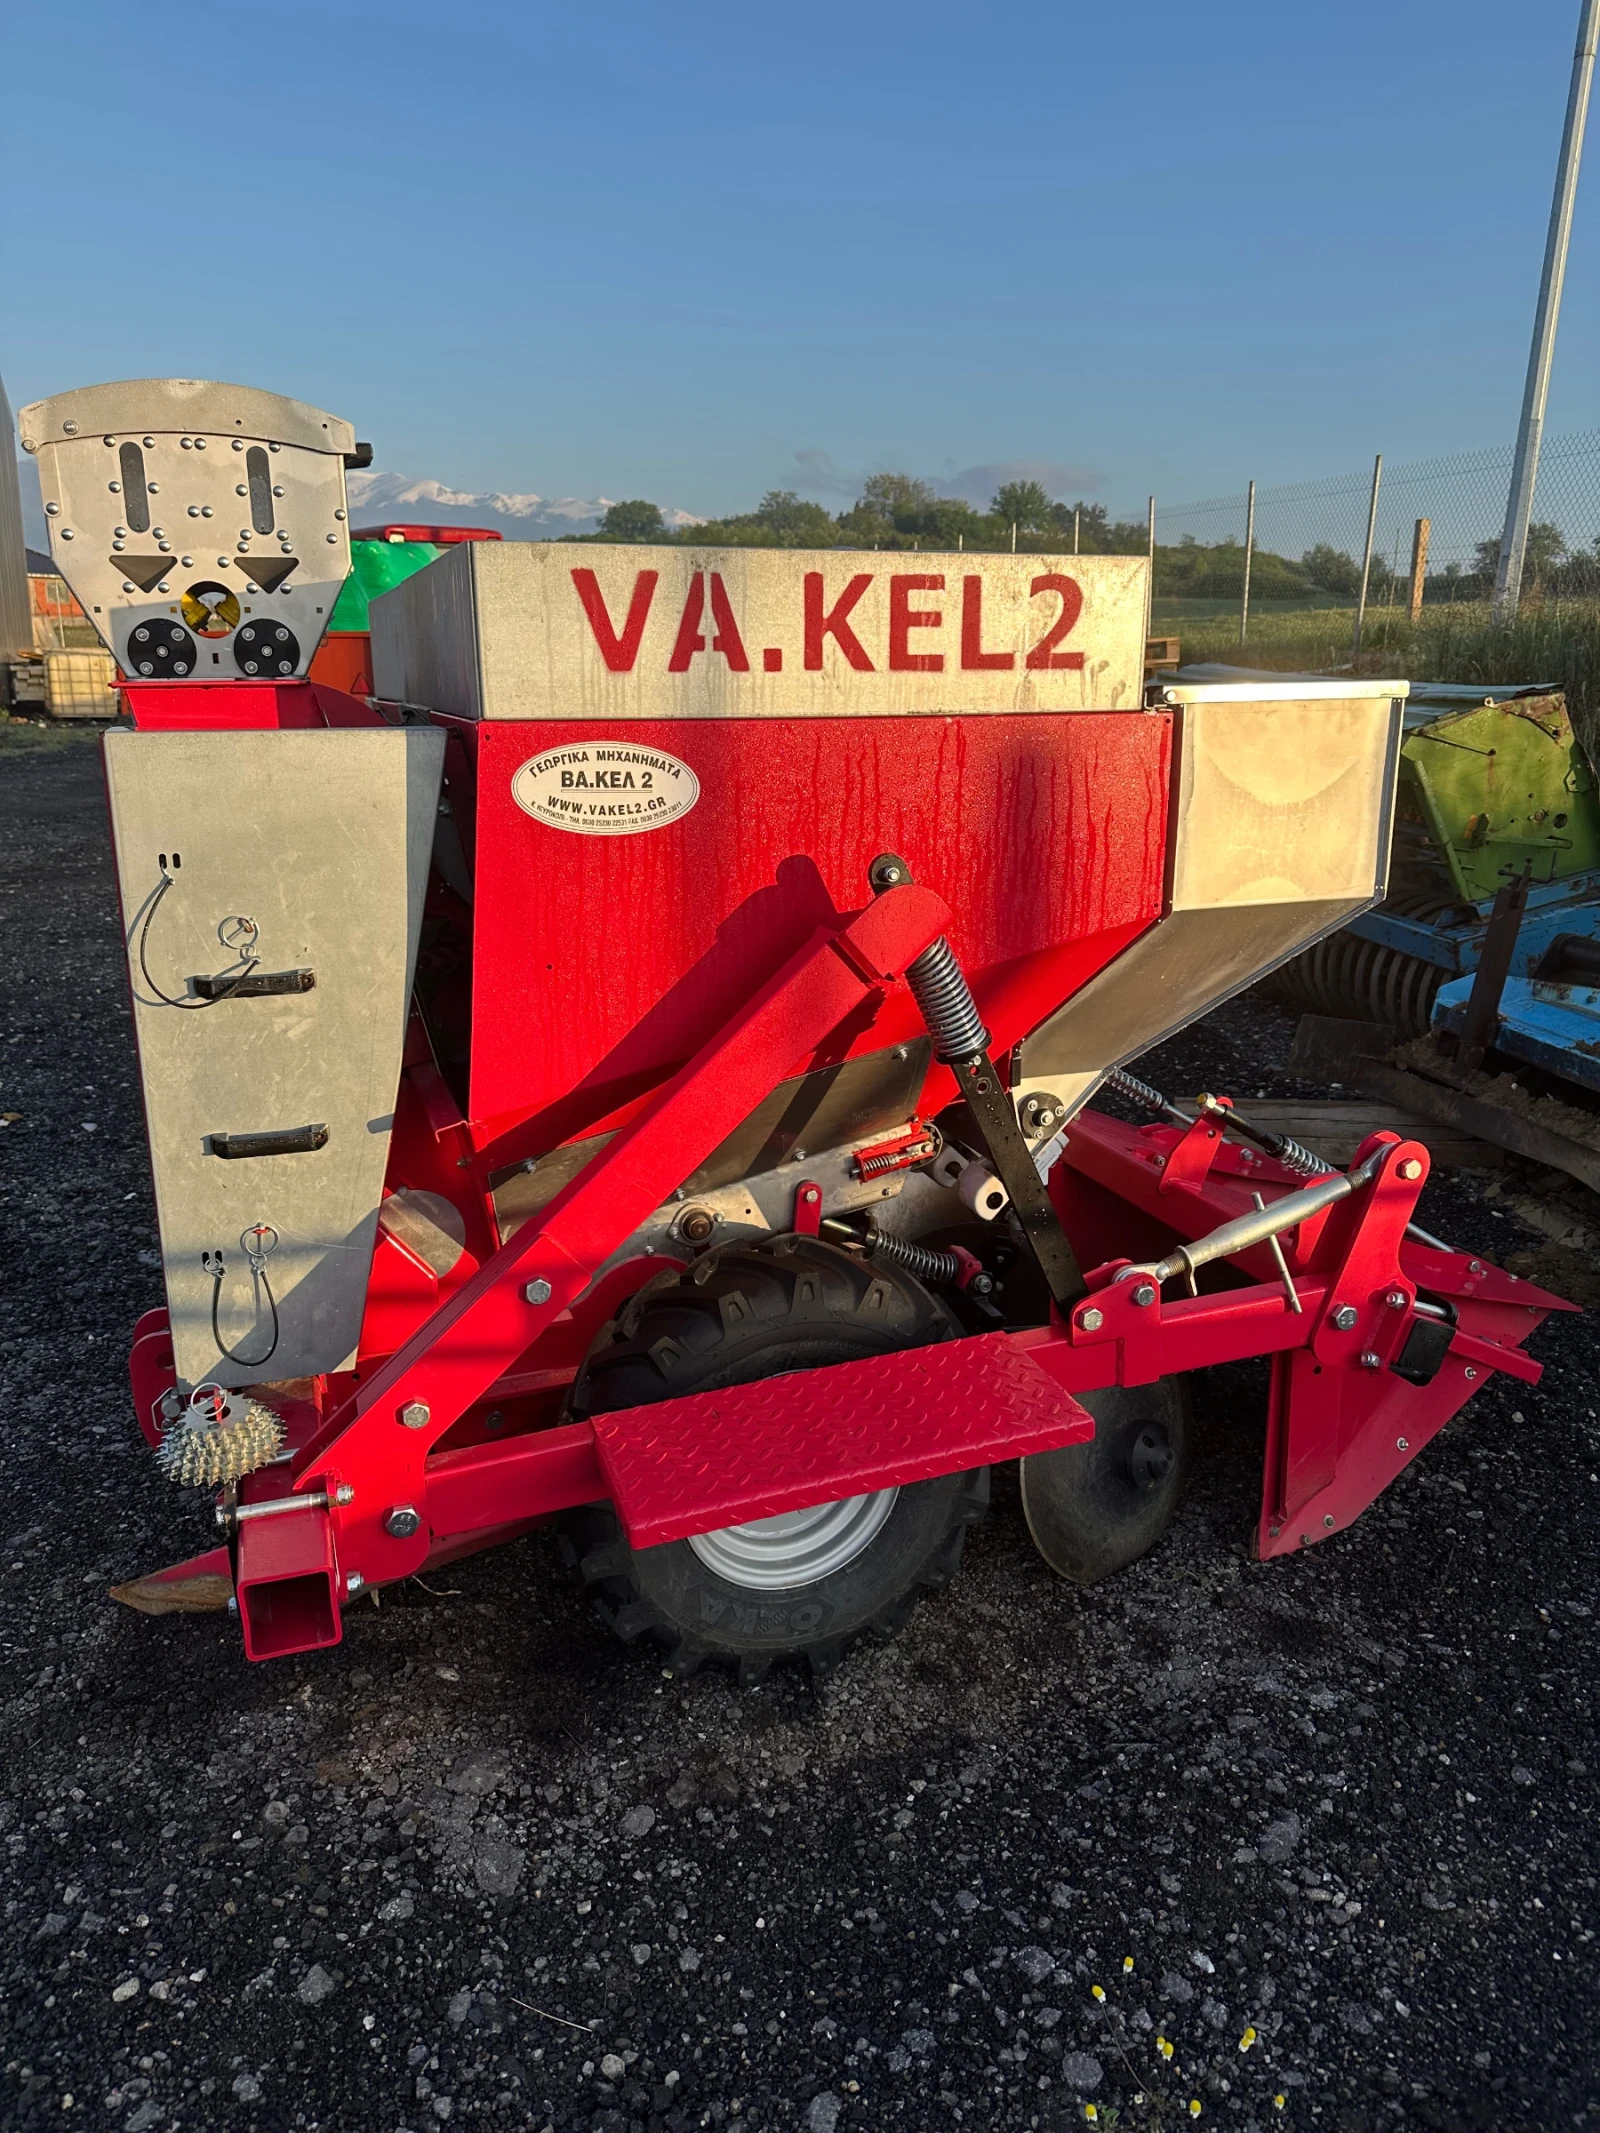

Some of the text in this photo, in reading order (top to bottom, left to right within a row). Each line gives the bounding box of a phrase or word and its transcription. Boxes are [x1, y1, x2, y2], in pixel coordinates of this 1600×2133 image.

[571, 568, 1085, 672] VA.KEL2
[529, 750, 682, 779] ΓΕΩΡΓΙΚΑ ΜΗΧΑΝΗΜΑΤΑ
[561, 770, 653, 789] ΒΑ.ΚΕΛ 2
[547, 795, 667, 816] WWW.VAKEL2.GR
